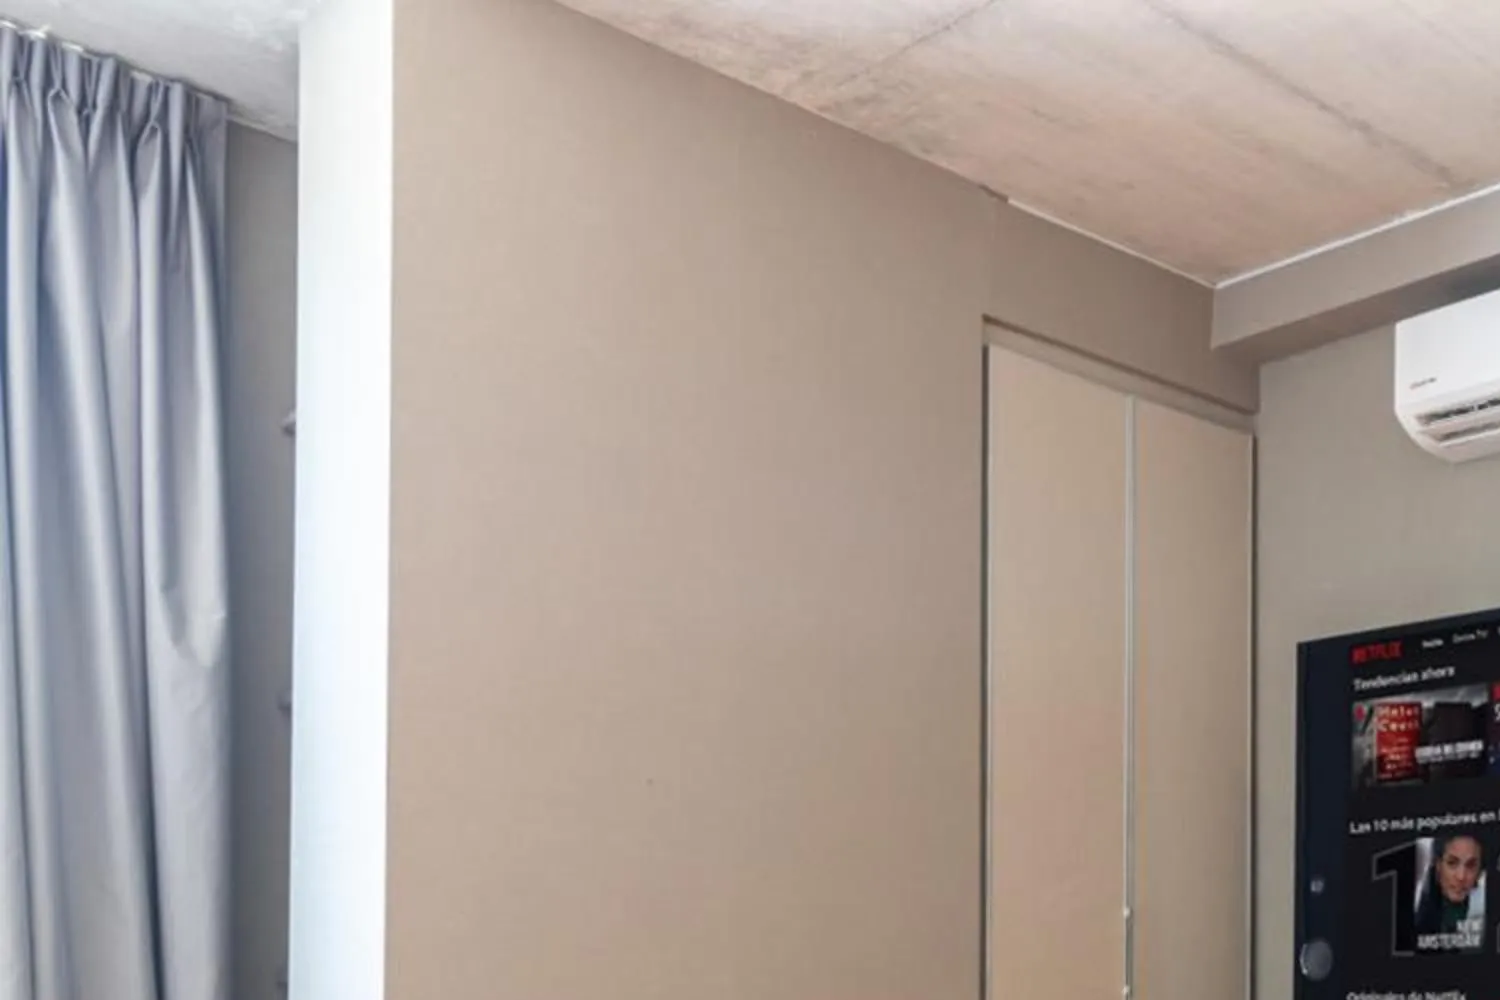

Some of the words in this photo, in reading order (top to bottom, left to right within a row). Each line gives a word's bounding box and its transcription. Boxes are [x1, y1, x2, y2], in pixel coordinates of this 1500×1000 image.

[1353, 671, 1418, 690] Tendencias
[1421, 666, 1455, 681] ahora
[1350, 821, 1371, 834] Las
[1373, 819, 1387, 831] 10
[1390, 817, 1414, 831] más
[1417, 812, 1477, 831] populares
[1479, 811, 1496, 823] en
